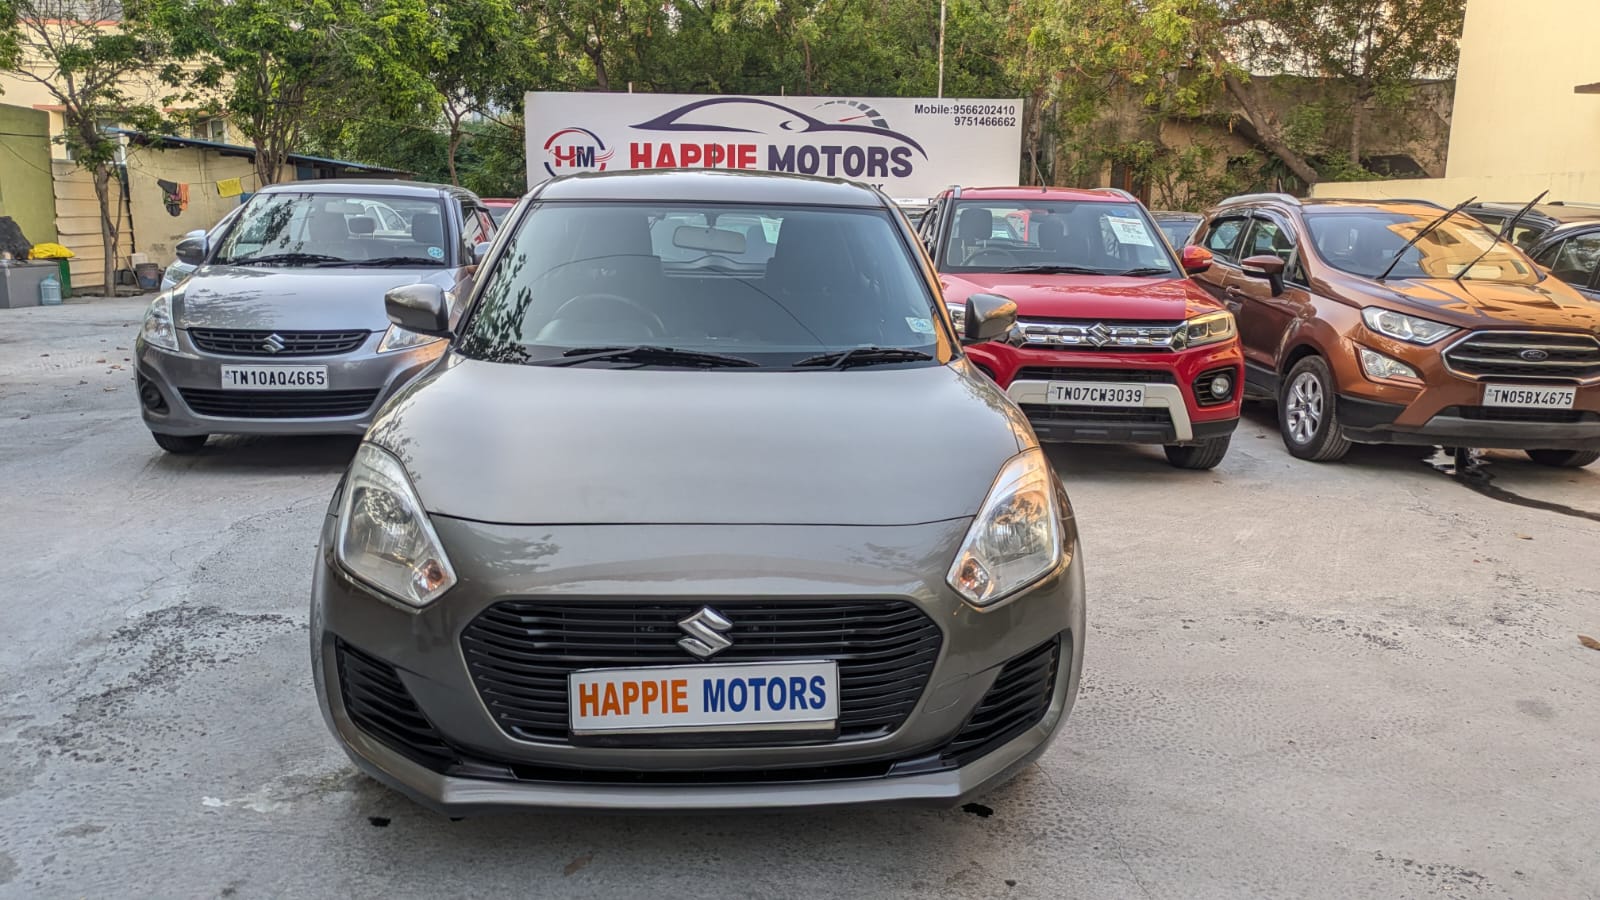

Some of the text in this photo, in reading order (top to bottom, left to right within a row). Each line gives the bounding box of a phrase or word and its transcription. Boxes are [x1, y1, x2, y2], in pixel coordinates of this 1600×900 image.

[914, 104, 1015, 115] Mobile:9566202410
[954, 116, 1016, 127] 9751466662
[554, 145, 595, 168] HM
[630, 142, 913, 178] HAPPIE MOTORS
[231, 370, 325, 385] TN10AQ4665
[1056, 386, 1142, 403] TN07CW3039
[1493, 389, 1573, 405] TN05BX4675
[579, 675, 826, 717] HAPPIE MOTORS
